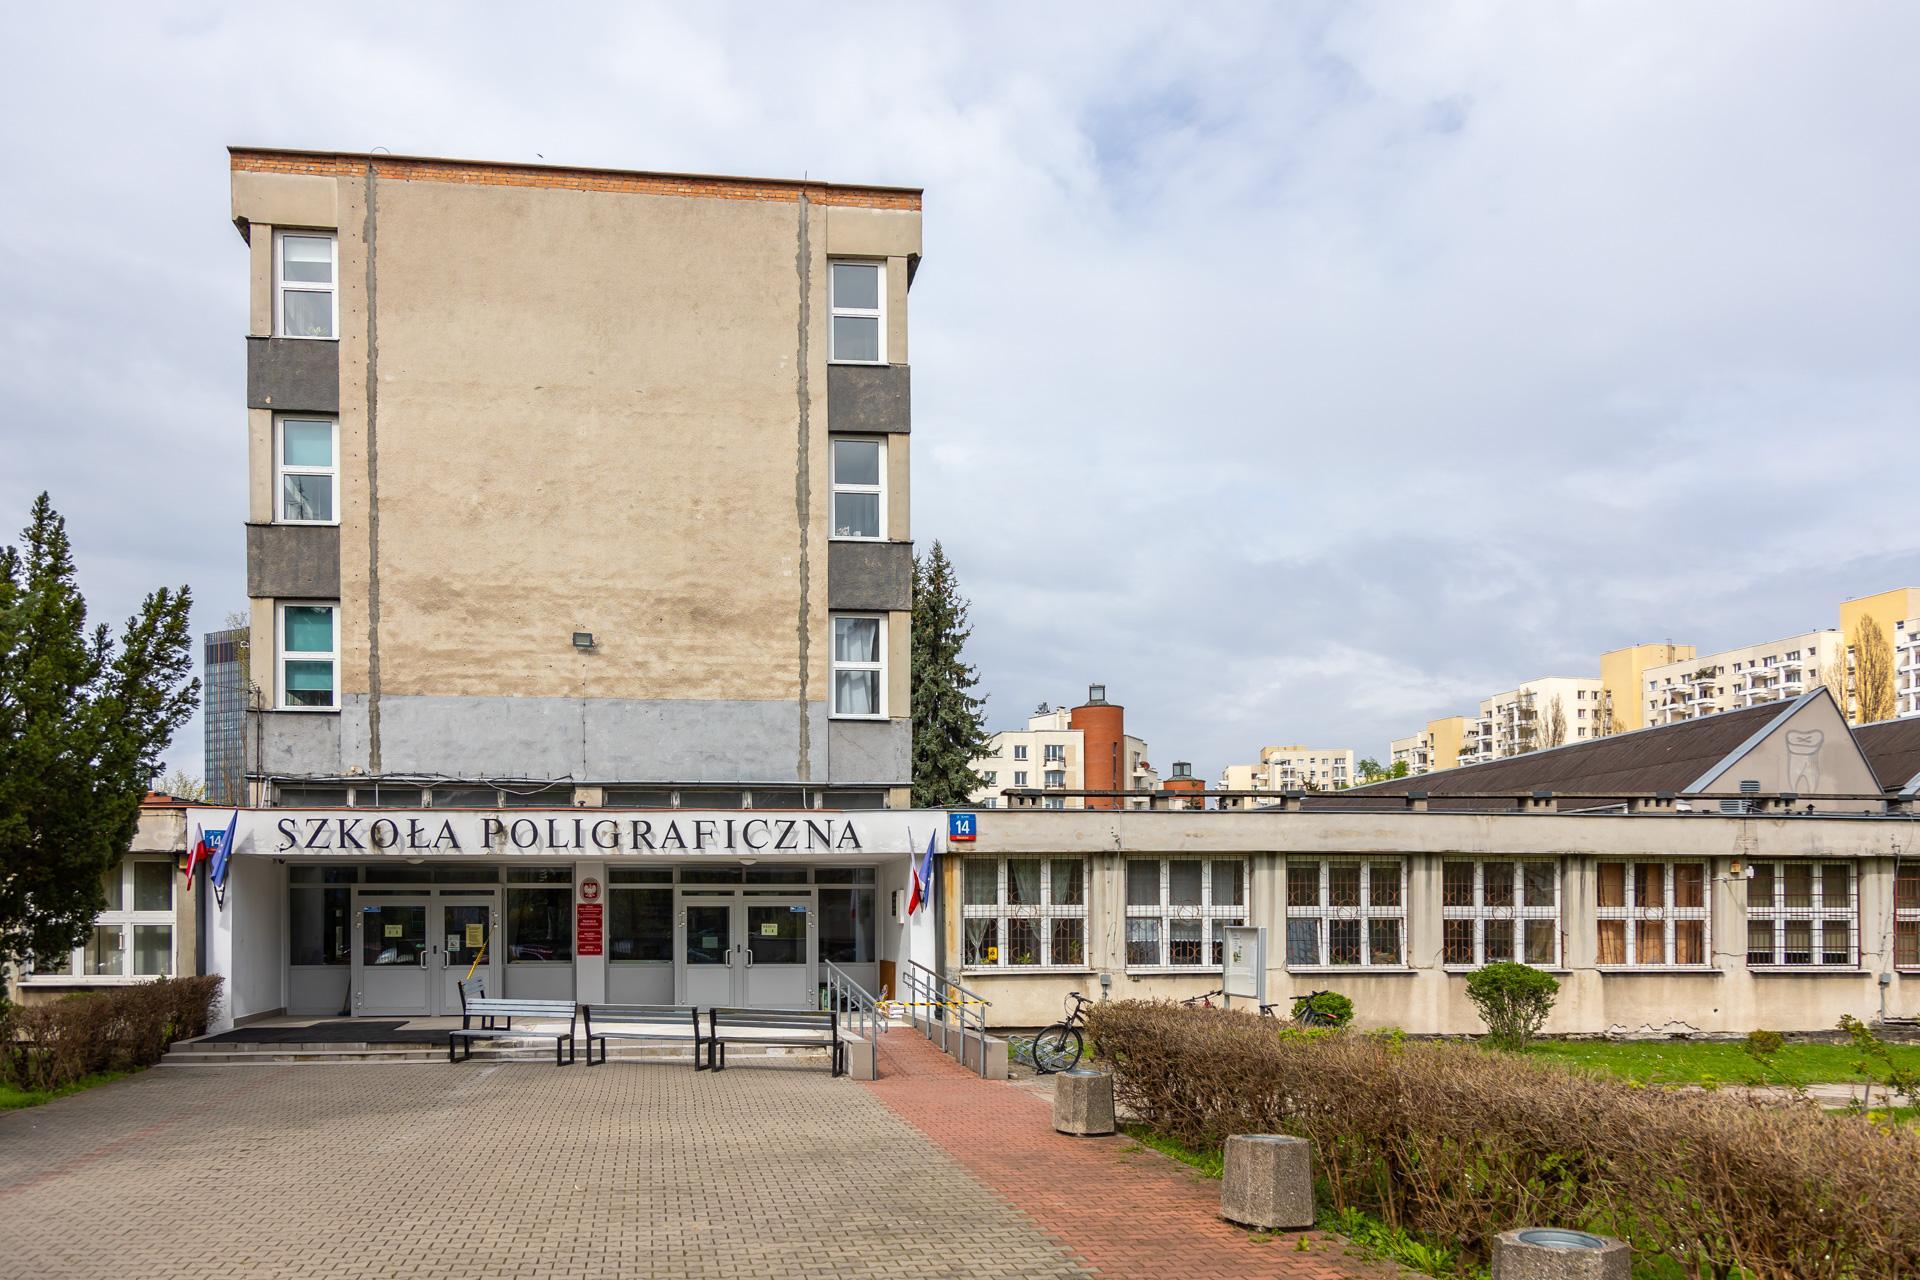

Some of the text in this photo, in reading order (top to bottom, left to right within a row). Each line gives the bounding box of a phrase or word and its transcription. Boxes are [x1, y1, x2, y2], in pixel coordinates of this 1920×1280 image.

[277, 818, 862, 850] SZKOŁA POLIGRAFICZNA
[955, 819, 971, 834] 14
[209, 835, 222, 847] 14
